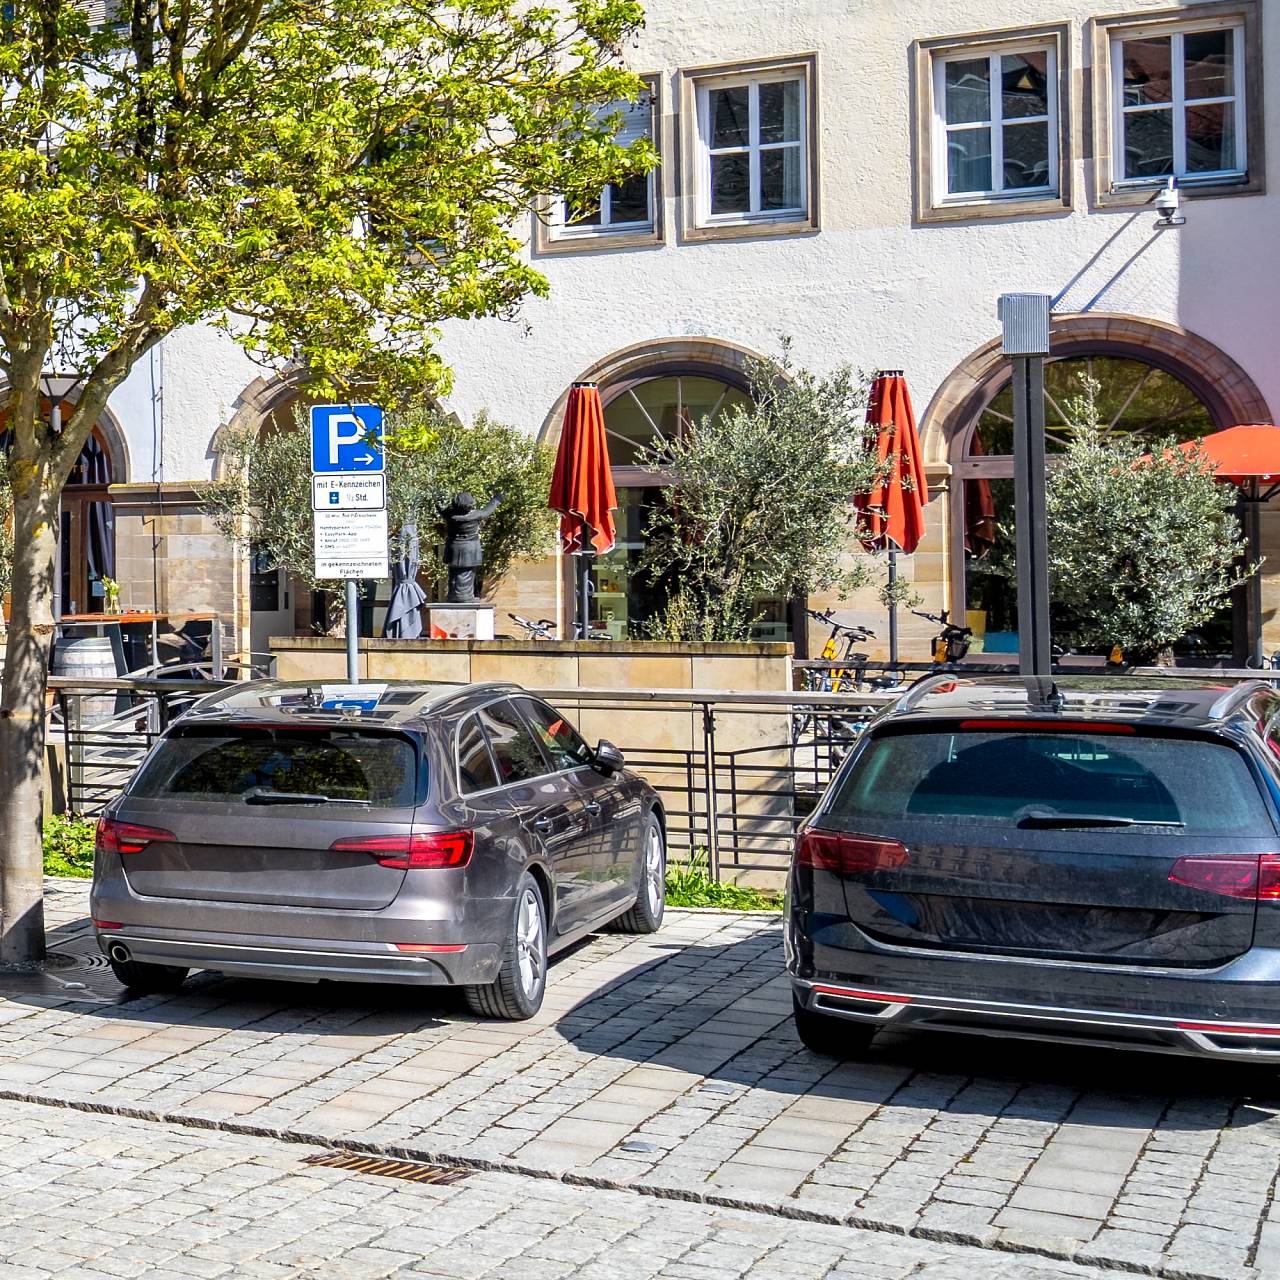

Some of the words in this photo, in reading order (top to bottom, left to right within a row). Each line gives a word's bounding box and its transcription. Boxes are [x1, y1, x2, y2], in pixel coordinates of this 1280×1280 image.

[328, 413, 367, 464] P
[316, 481, 328, 489] mit
[330, 480, 381, 489] E-Kennzeichen
[355, 493, 369, 502] Std.
